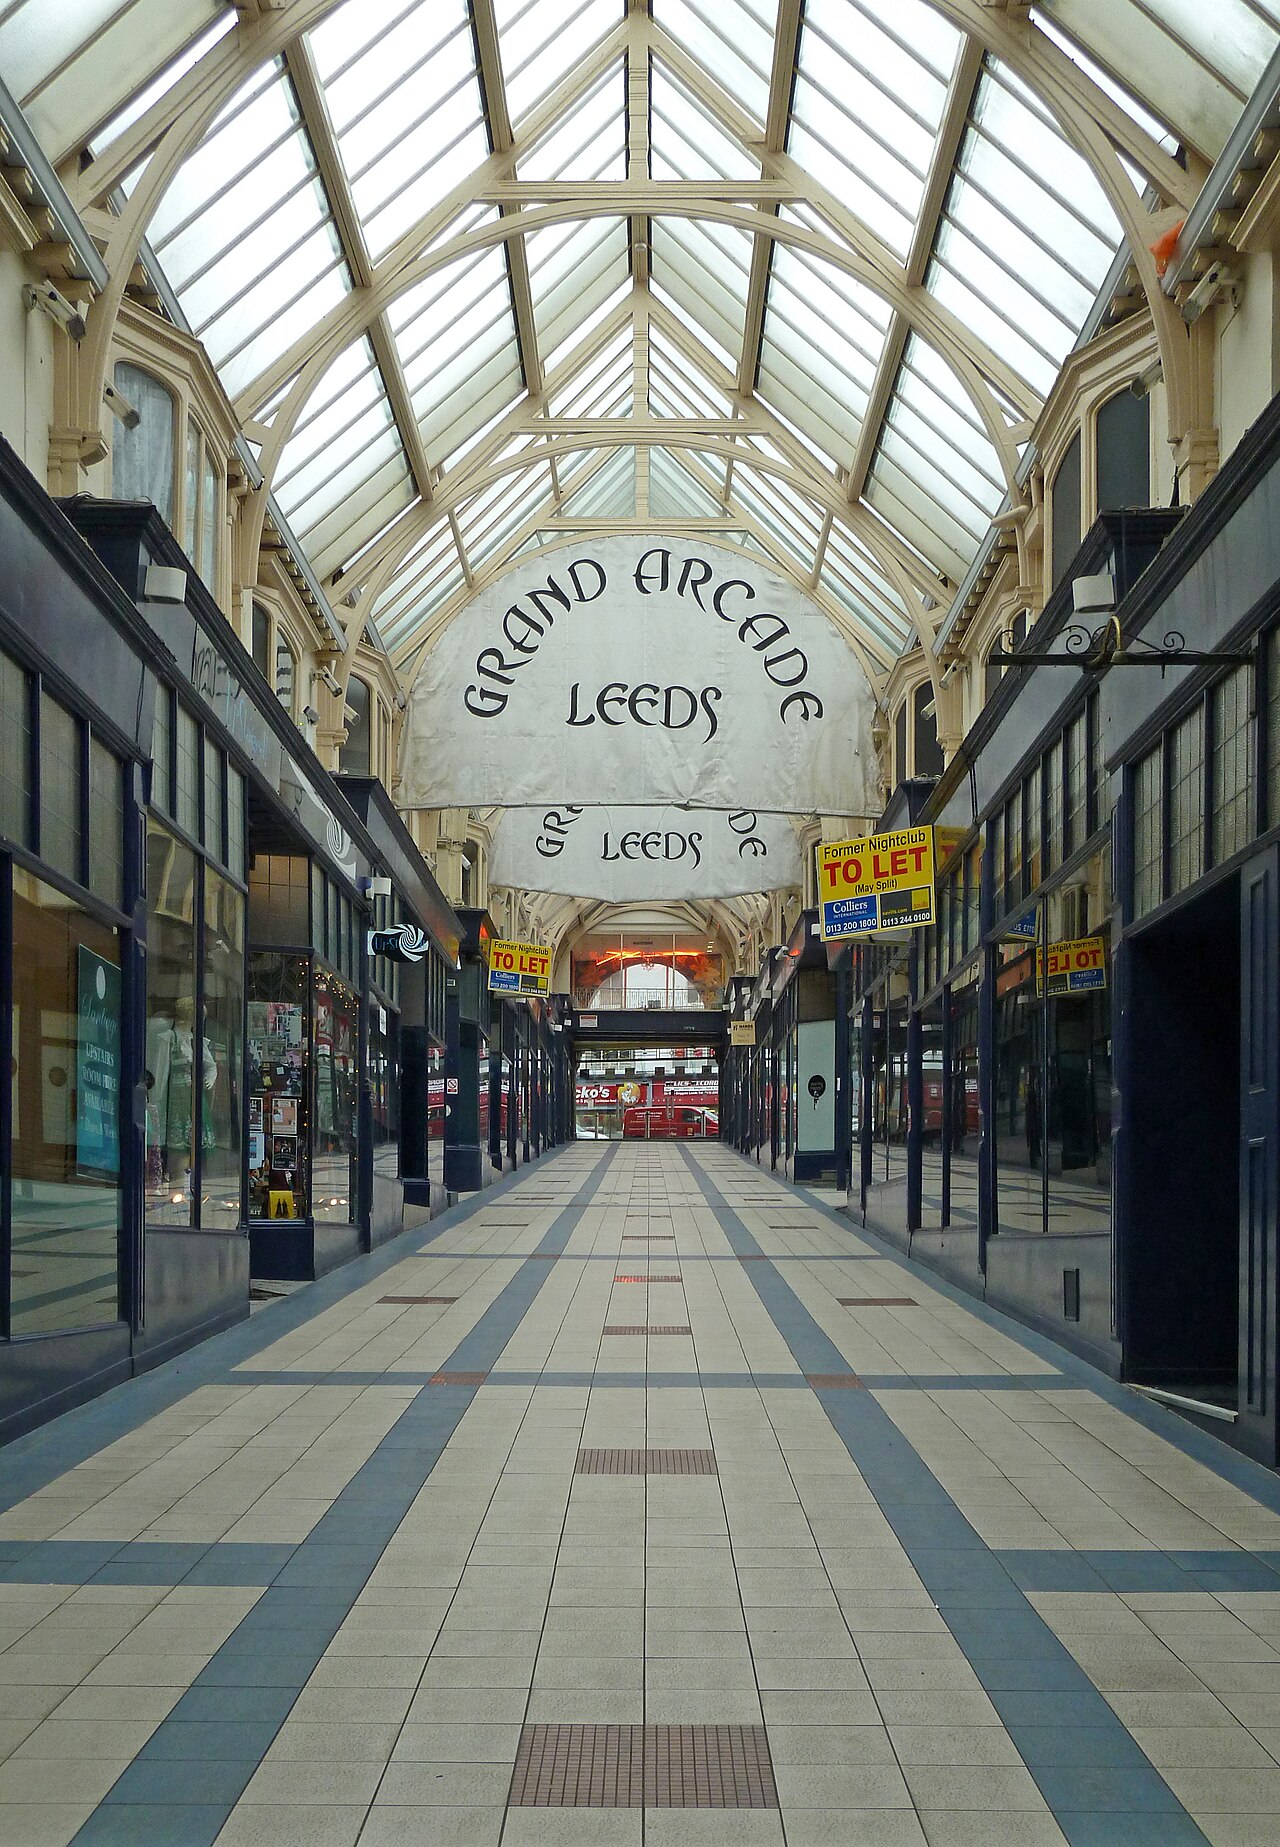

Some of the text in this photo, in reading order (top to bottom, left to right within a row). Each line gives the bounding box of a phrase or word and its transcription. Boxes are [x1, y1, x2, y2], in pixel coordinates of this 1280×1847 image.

[464, 559, 607, 718] GRAND
[632, 549, 823, 724] ARCADE
[566, 683, 722, 745] LEEDS
[601, 831, 703, 870] LEEDS
[825, 843, 866, 860] Former
[869, 830, 926, 852] Nightclub
[824, 846, 927, 887] TO LET
[855, 879, 897, 896] (May Split)
[833, 901, 868, 914] Colliers
[882, 912, 930, 926] 0113 244 0100
[826, 924, 841, 933] 0113
[843, 921, 858, 930] 200
[859, 918, 877, 928] 1800
[494, 941, 549, 955] Former Nightclub
[493, 952, 549, 975] TO LET
[86, 1043, 114, 1067] UPSTAIRS
